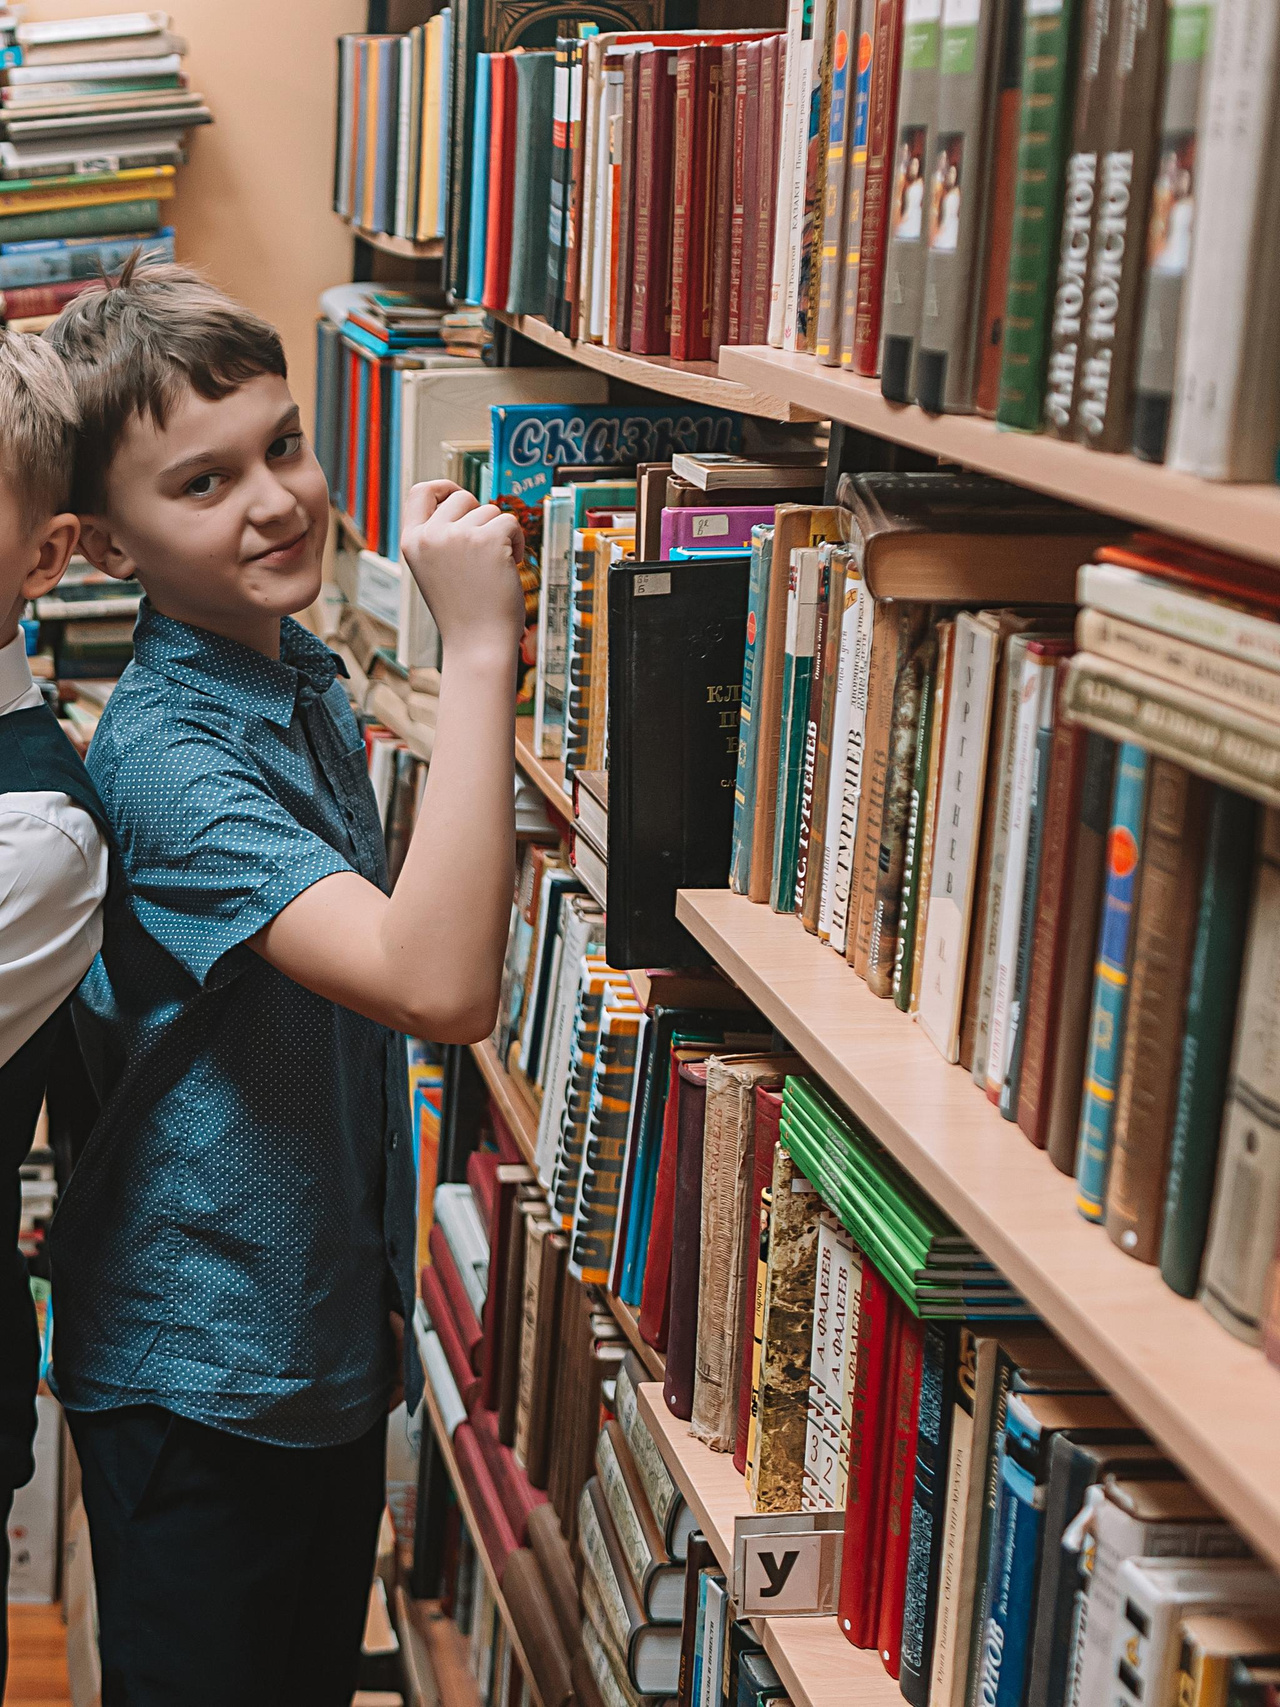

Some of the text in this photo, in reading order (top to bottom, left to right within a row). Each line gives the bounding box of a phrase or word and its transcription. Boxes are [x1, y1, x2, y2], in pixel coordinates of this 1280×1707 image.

[800, 68, 808, 115] рассказы
[795, 128, 804, 170] Повести
[792, 181, 800, 230] КАЗАКИ
[794, 720, 817, 907] И.С. ТУРГЕНЕВ
[836, 729, 861, 874] ТУРГЕНЕВ
[862, 750, 886, 894] ТУРГЕНЕВ
[816, 1246, 832, 1365] А. ФАДЕЕВ
[831, 1266, 848, 1384] А. ФАДЕЕВ
[847, 1289, 861, 1380] ФАДЕЕВ
[809, 1434, 819, 1463] 3
[823, 1456, 834, 1486] 2
[953, 1448, 963, 1505] МУХТАРА
[757, 1550, 800, 1598] У
[944, 1553, 954, 1601] СМЕРТЬ
[940, 1606, 949, 1650] Тынянов
[936, 1652, 945, 1685] Юрий
